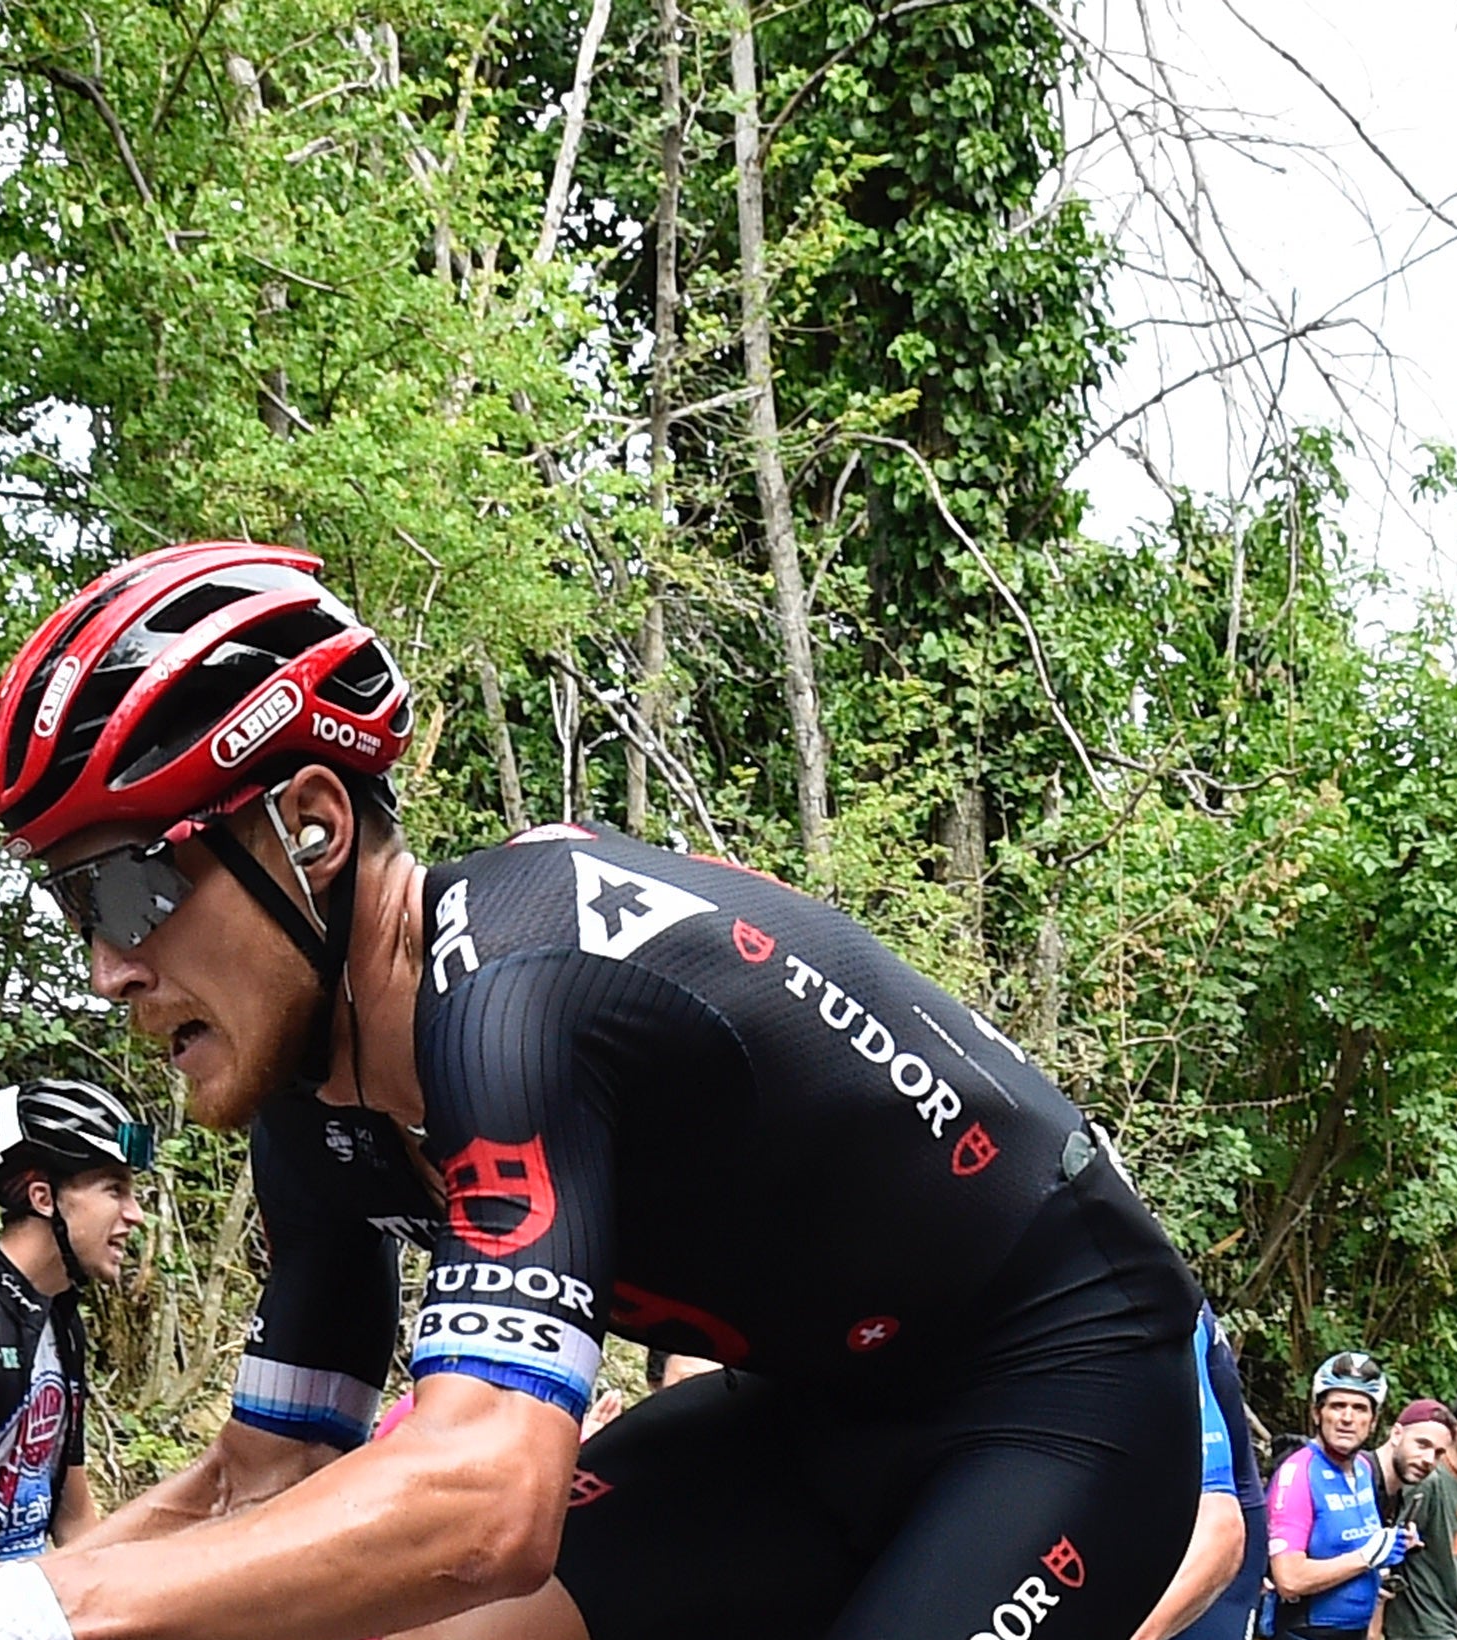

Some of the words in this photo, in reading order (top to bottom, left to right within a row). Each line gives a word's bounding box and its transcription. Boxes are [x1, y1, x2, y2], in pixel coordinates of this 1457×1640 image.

[224, 689, 294, 758] ABUS
[312, 712, 356, 747] 100
[431, 878, 480, 994] BMC
[785, 955, 962, 1139] TUDOR
[428, 1263, 594, 1318] UDOR
[419, 1312, 562, 1353] BOSS
